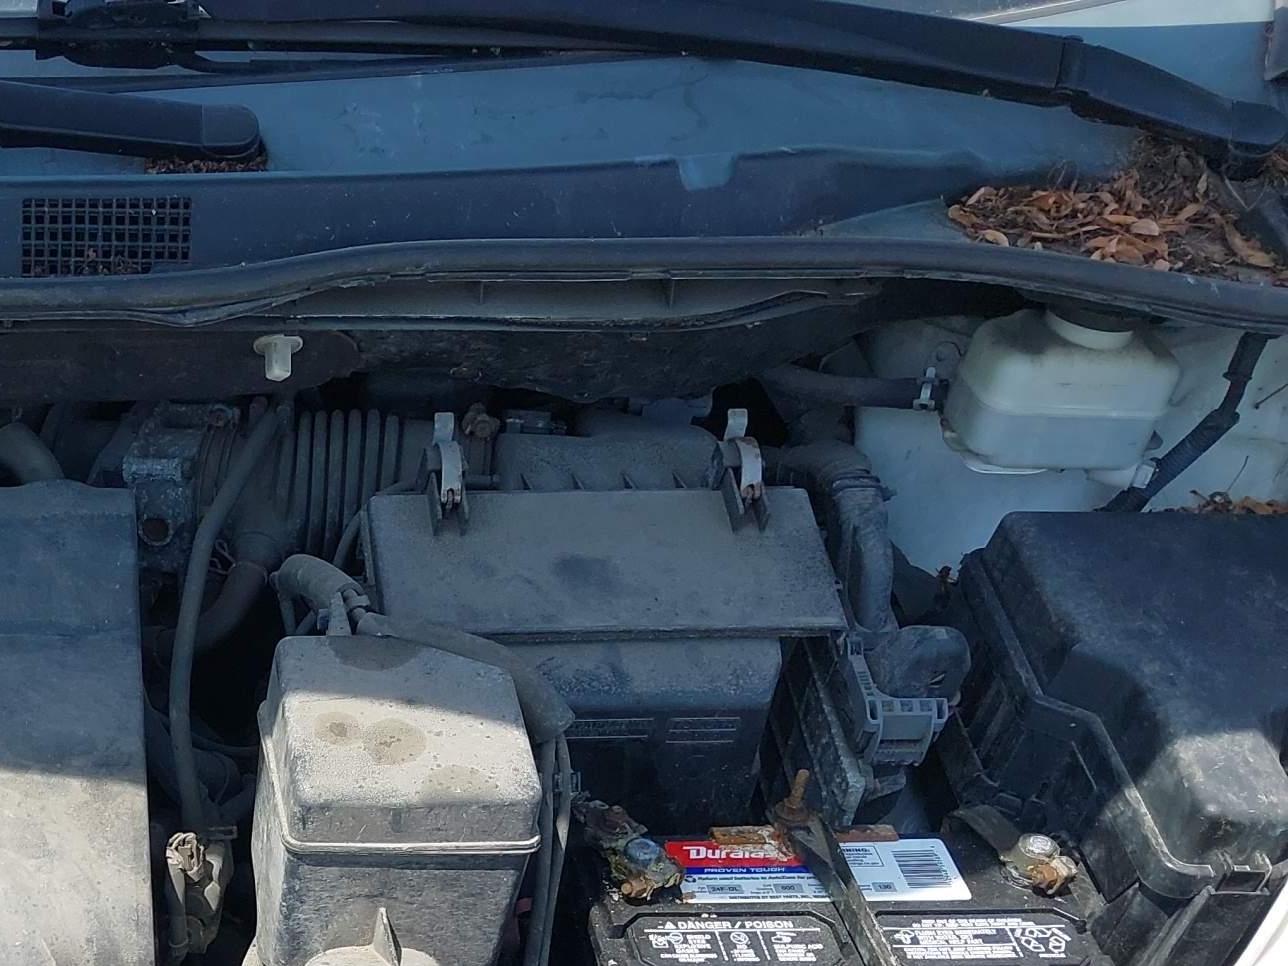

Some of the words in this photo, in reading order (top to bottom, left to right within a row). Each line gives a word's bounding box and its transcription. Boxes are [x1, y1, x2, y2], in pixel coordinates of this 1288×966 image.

[682, 845, 779, 860] Duralas
[678, 920, 732, 929] DANGER
[734, 920, 742, 928] /
[744, 920, 794, 928] POISON
